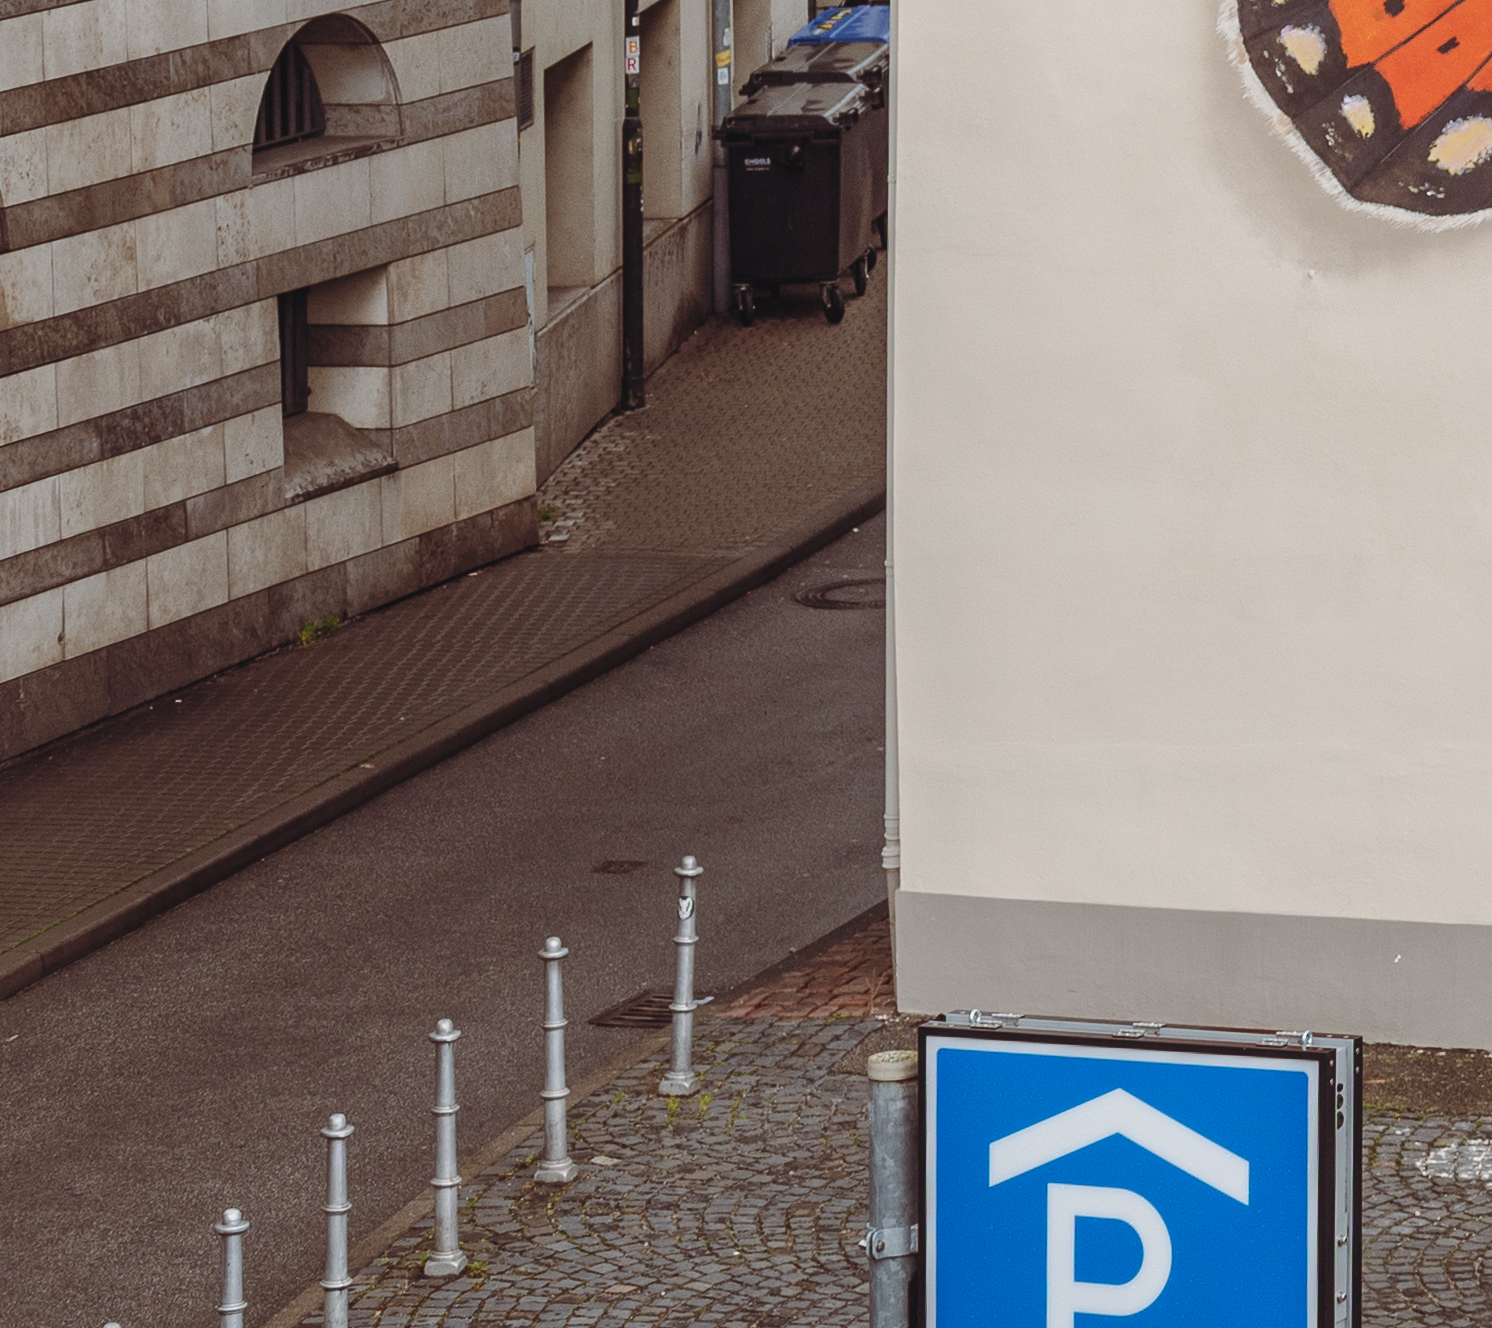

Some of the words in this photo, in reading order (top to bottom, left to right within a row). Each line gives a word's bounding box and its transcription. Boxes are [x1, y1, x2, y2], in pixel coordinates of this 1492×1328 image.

[629, 40, 638, 54] B
[627, 57, 637, 71] R
[1047, 1183, 1172, 1328] P
